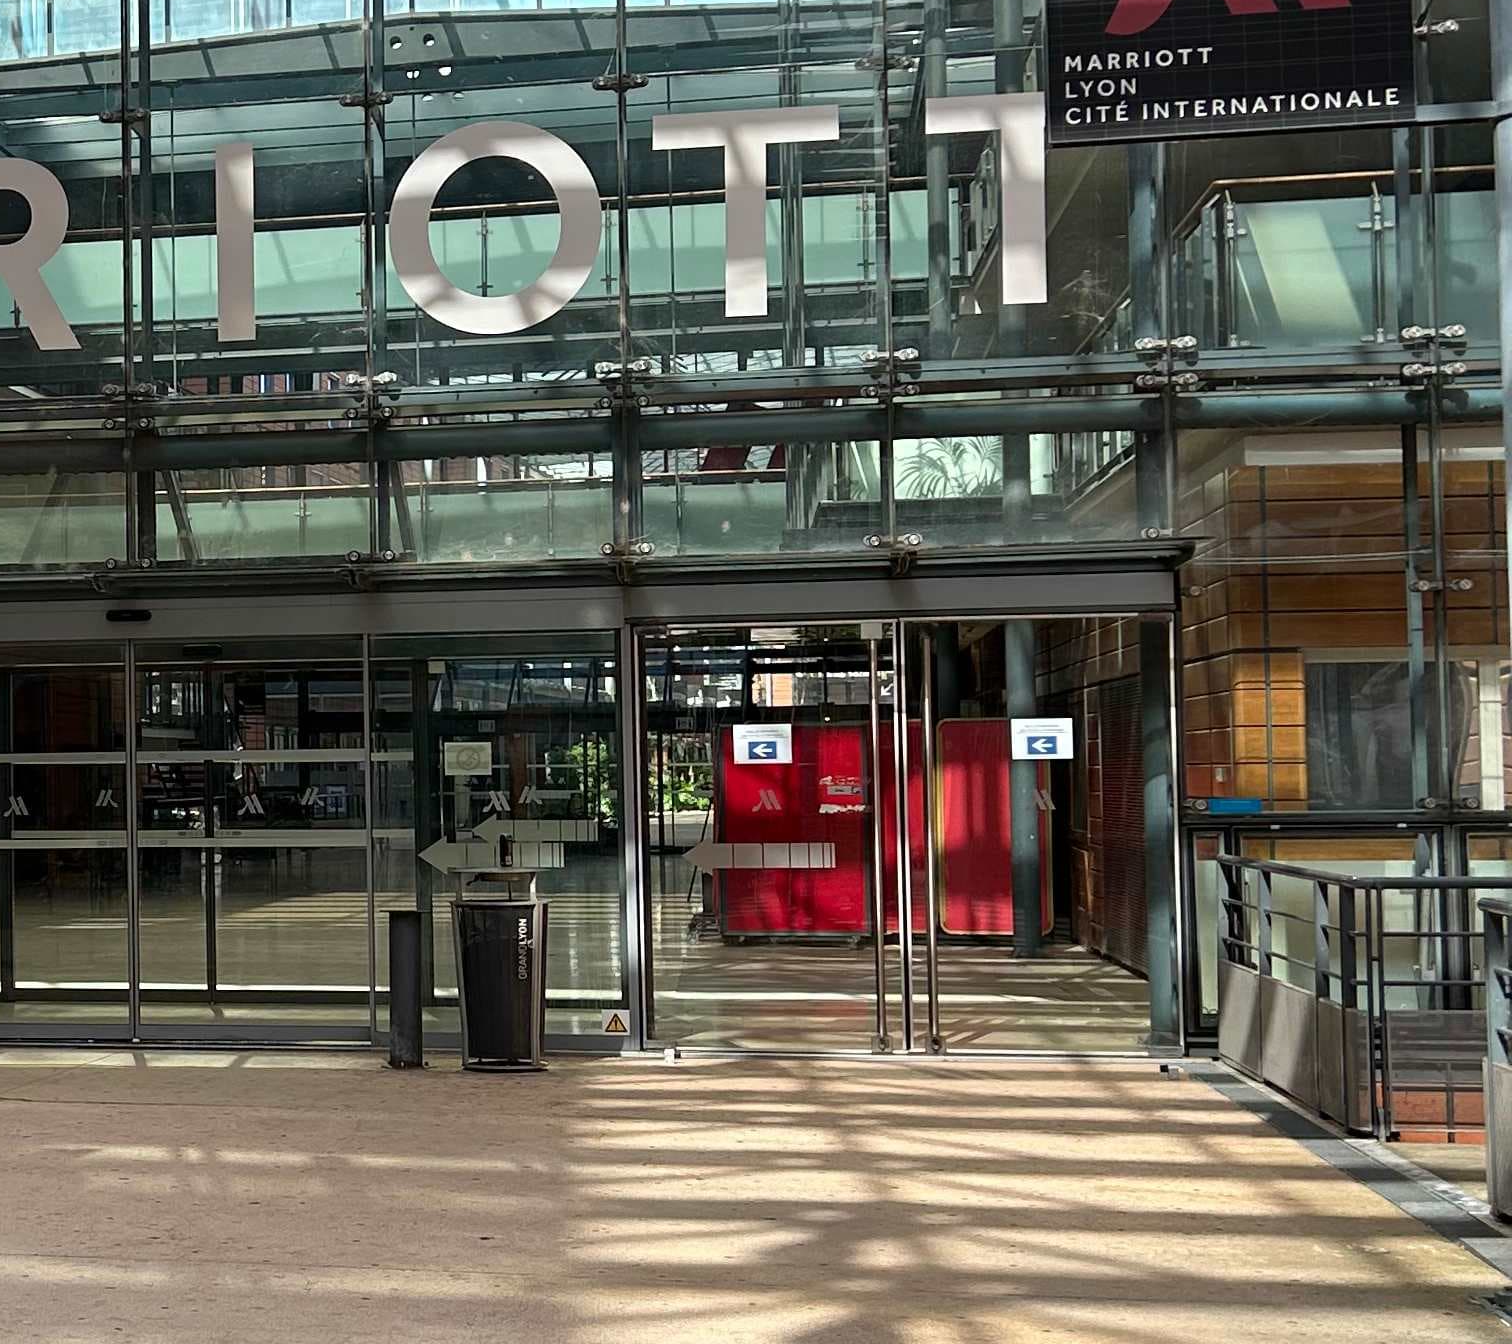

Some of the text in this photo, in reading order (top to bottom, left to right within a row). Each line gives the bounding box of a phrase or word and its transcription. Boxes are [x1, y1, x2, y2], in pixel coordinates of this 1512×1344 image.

[1064, 46, 1216, 74] MARRIOTT
[1064, 77, 1138, 100] LYON
[1064, 87, 1402, 126] CITÉ INTERNATIONALE
